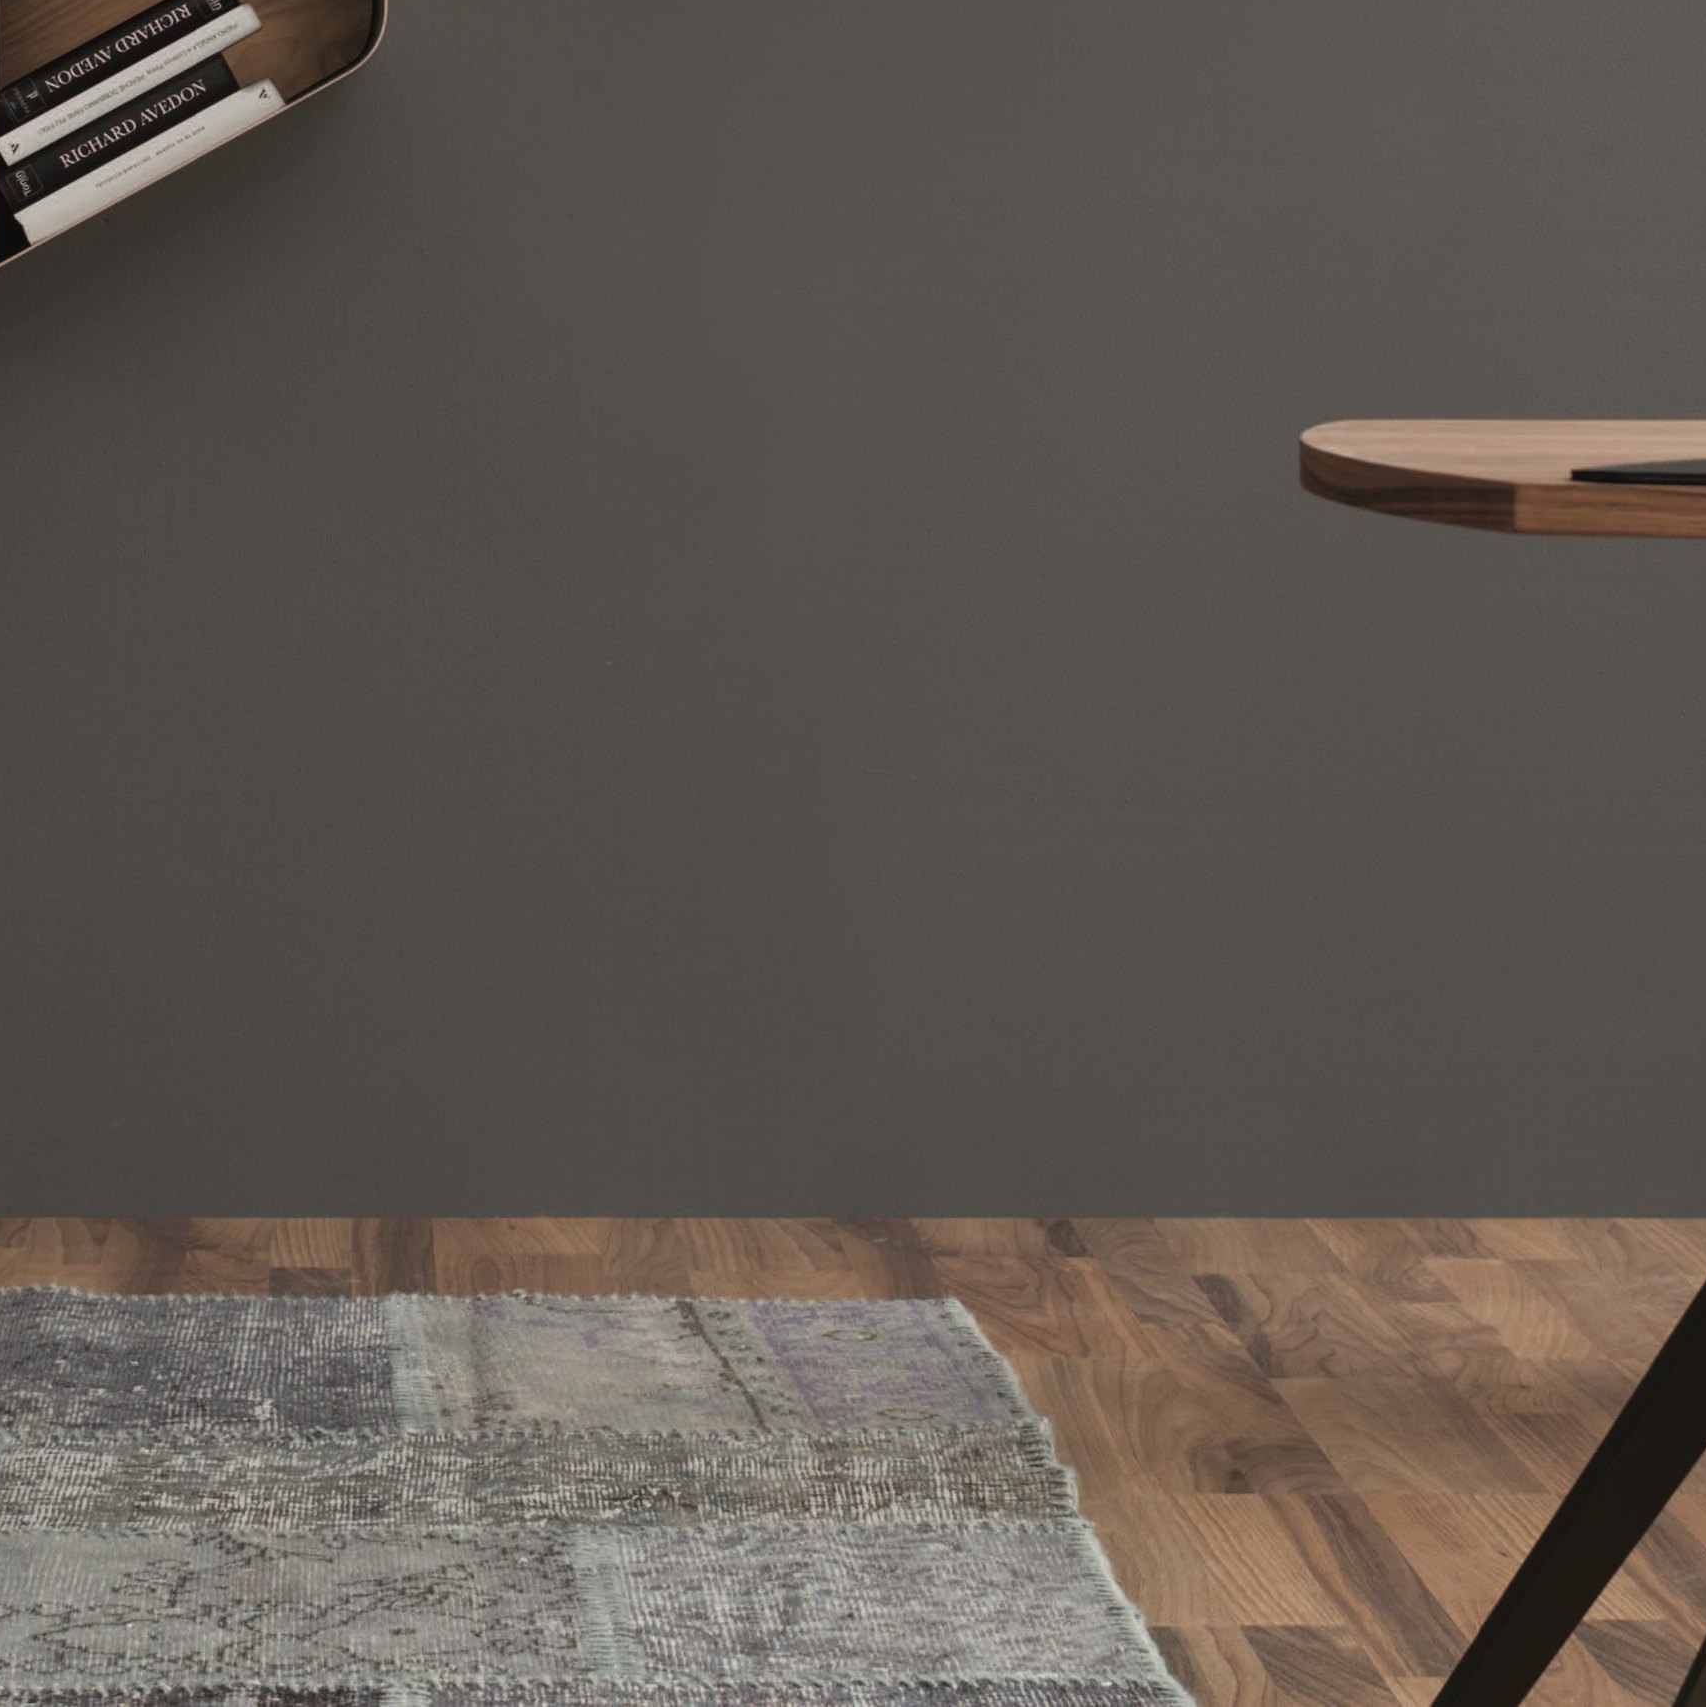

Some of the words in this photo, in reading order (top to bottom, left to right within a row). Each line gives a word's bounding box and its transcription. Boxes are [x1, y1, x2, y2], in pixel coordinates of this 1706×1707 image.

[113, 3, 191, 53] RICHARD
[44, 45, 113, 92] AVEDON
[58, 117, 137, 168] RICHARD
[138, 78, 207, 125] AVEDON
